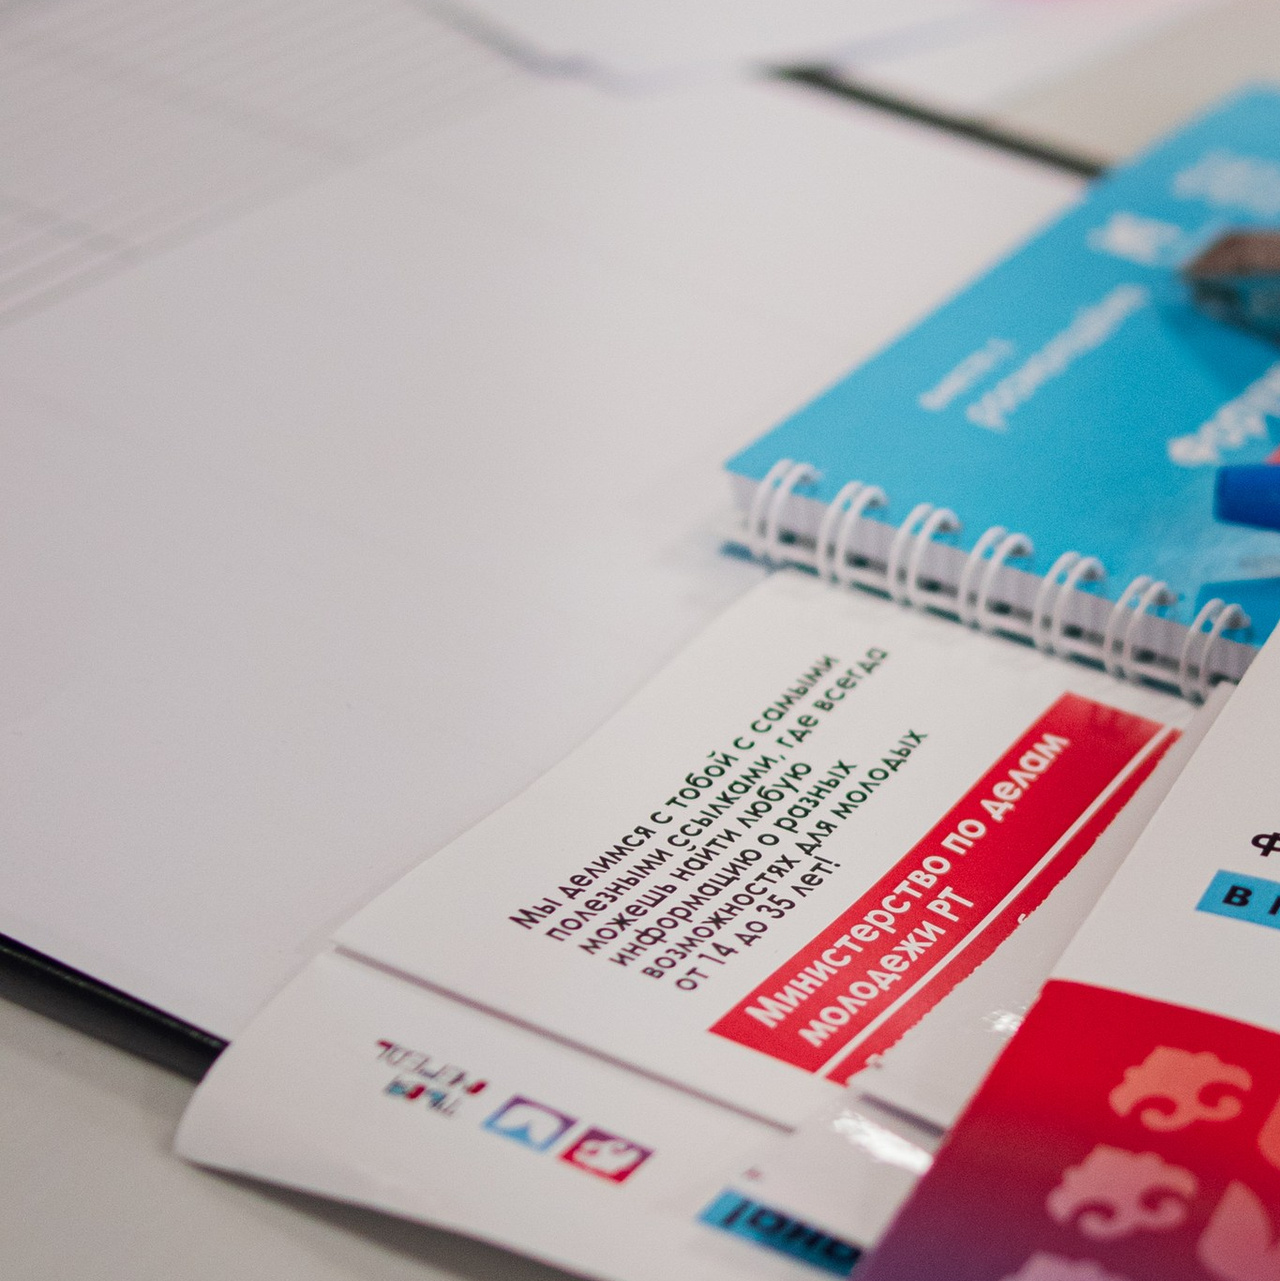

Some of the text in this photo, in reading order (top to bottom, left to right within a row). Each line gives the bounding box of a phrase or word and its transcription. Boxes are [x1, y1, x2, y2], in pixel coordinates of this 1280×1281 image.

[508, 654, 840, 930] Мы делимся с тобой с самыми
[545, 646, 890, 942] полезными ссылками, где всегда
[578, 761, 813, 956] можешь найти любую
[609, 758, 859, 968] информацию о разных
[641, 728, 929, 980] возможностях для молодых
[744, 732, 1072, 1029] Министерство по делам
[1220, 885, 1254, 908] в
[675, 855, 842, 991] от 14 до 35 лет!
[797, 885, 975, 1049] молодежи РТ
